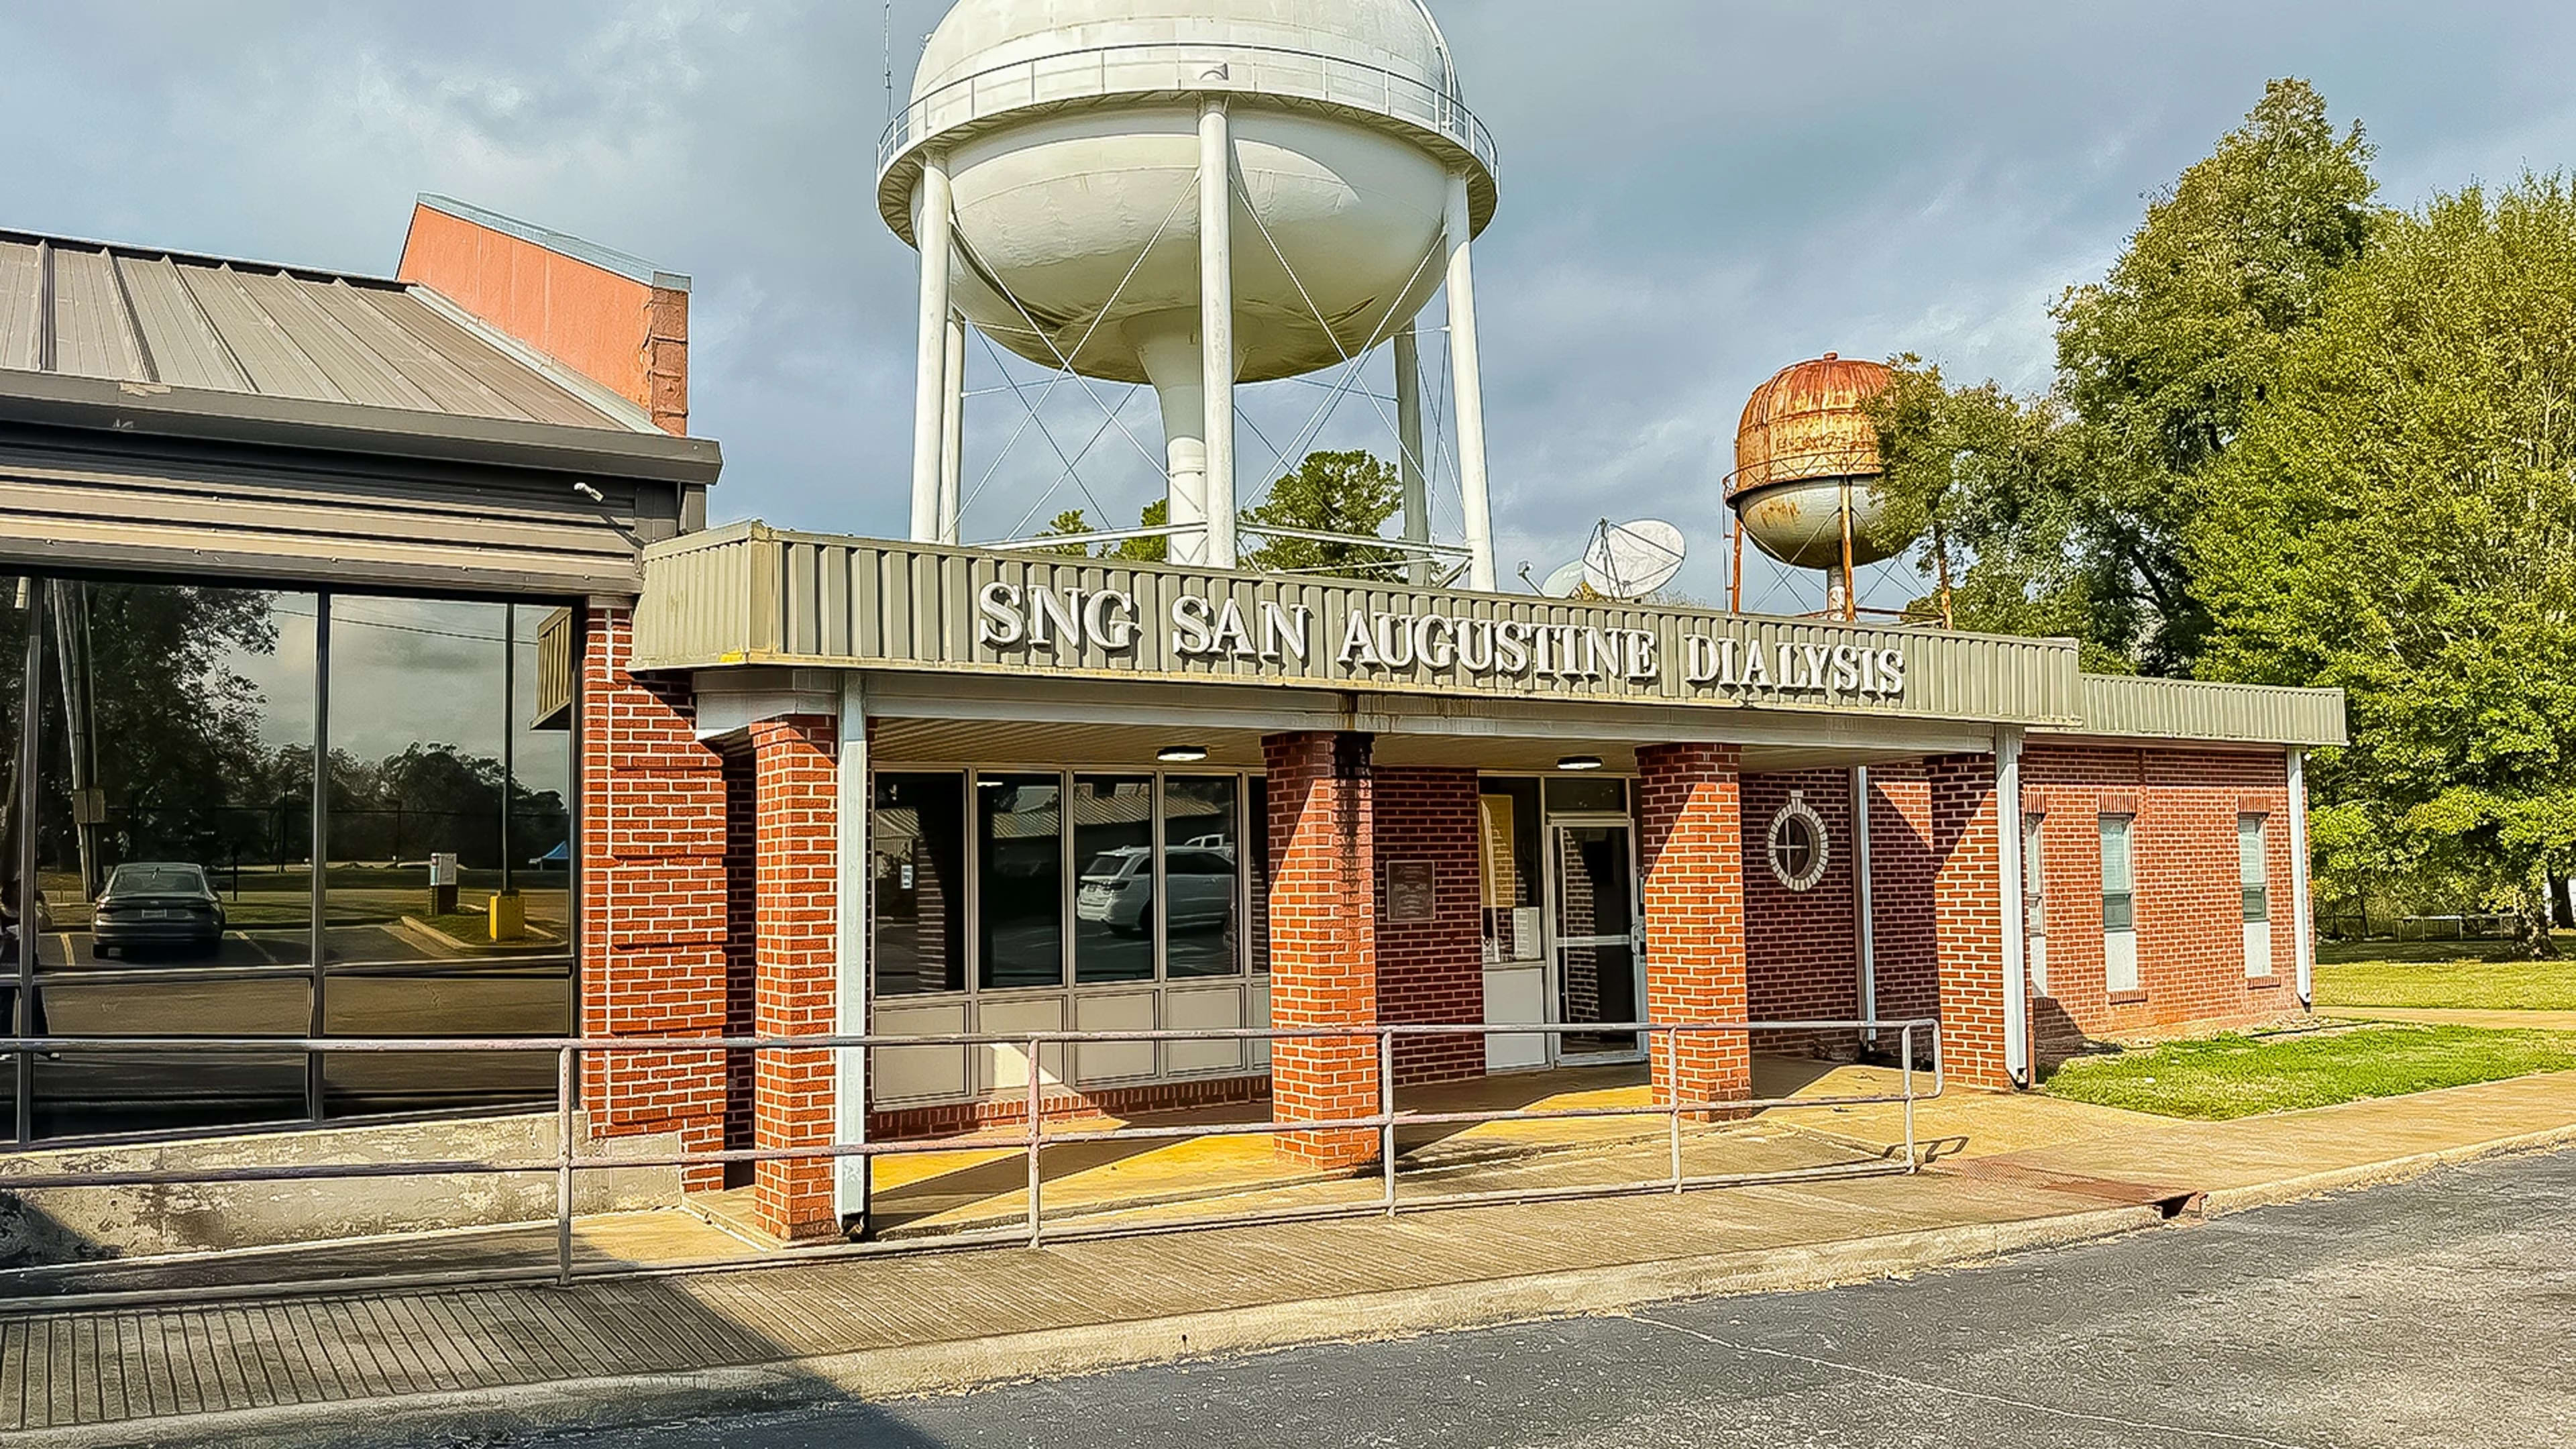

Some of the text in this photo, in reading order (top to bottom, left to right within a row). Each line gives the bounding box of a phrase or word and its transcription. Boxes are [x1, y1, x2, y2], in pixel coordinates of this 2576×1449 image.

[979, 581, 1905, 694] SNG SAN AUGUSTINE DIALYSIS
